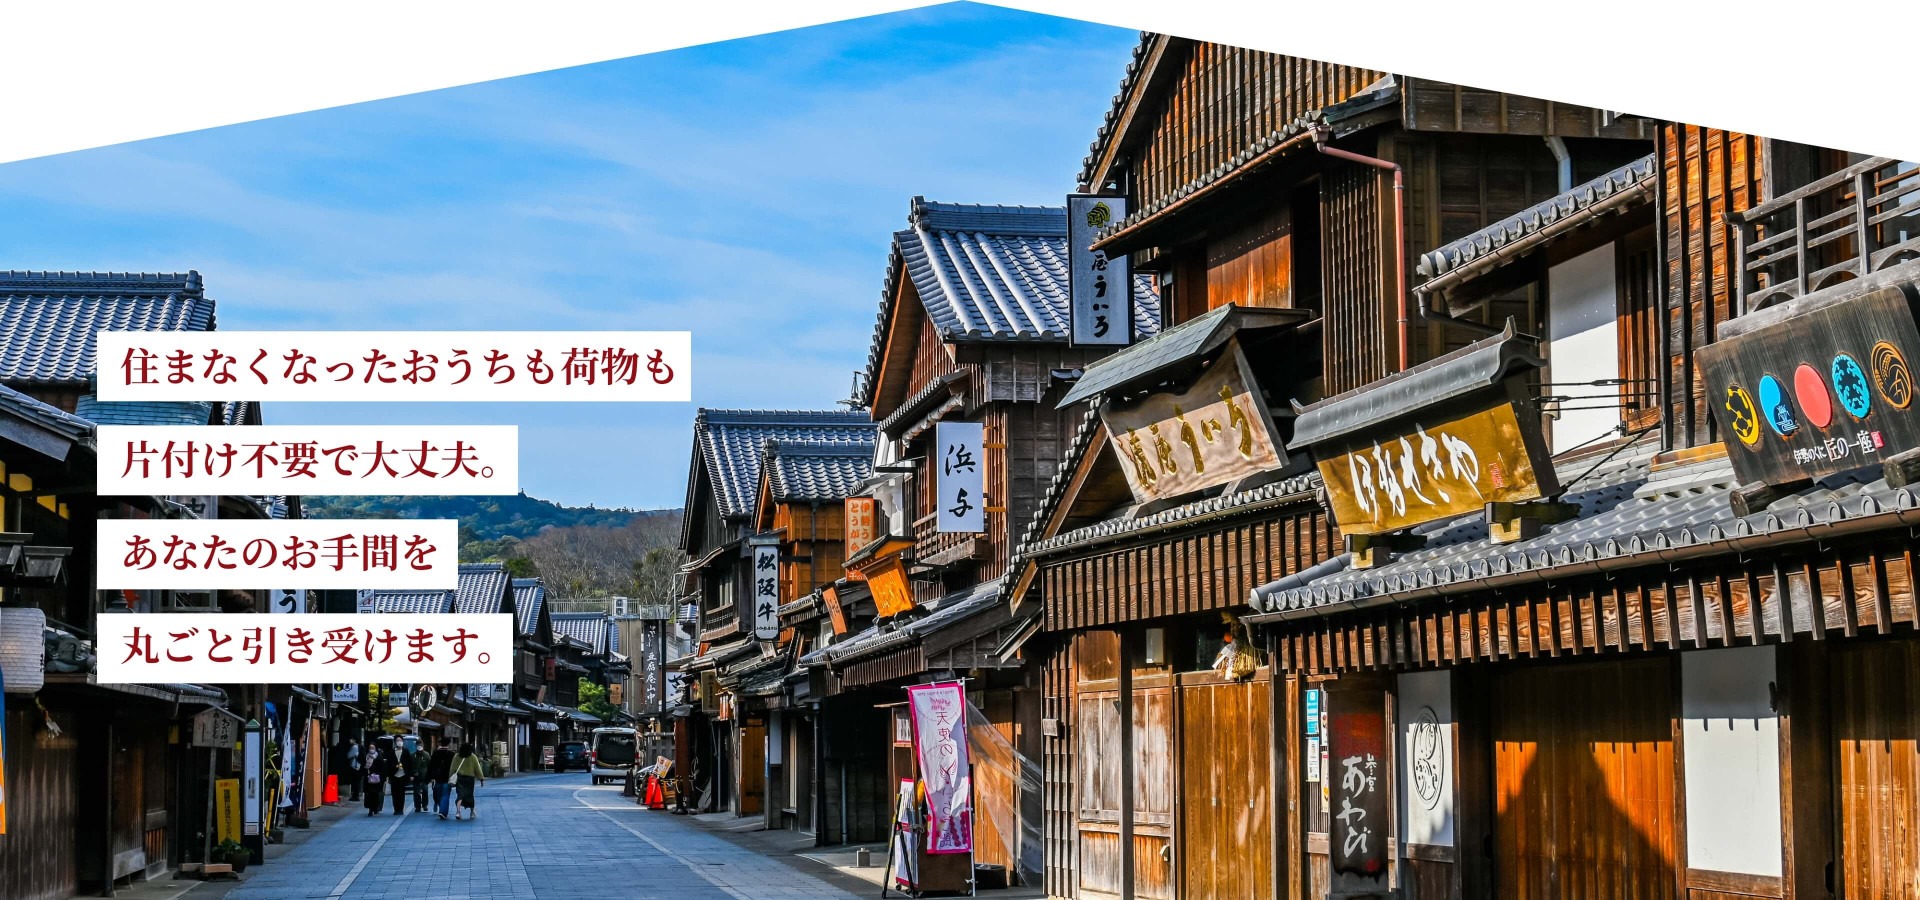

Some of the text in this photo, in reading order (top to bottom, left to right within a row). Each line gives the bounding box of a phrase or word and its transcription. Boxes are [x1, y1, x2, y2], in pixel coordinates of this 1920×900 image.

[944, 443, 976, 519] 浜与
[757, 552, 777, 622] 松阪牛
[1336, 755, 1372, 858] あわび
